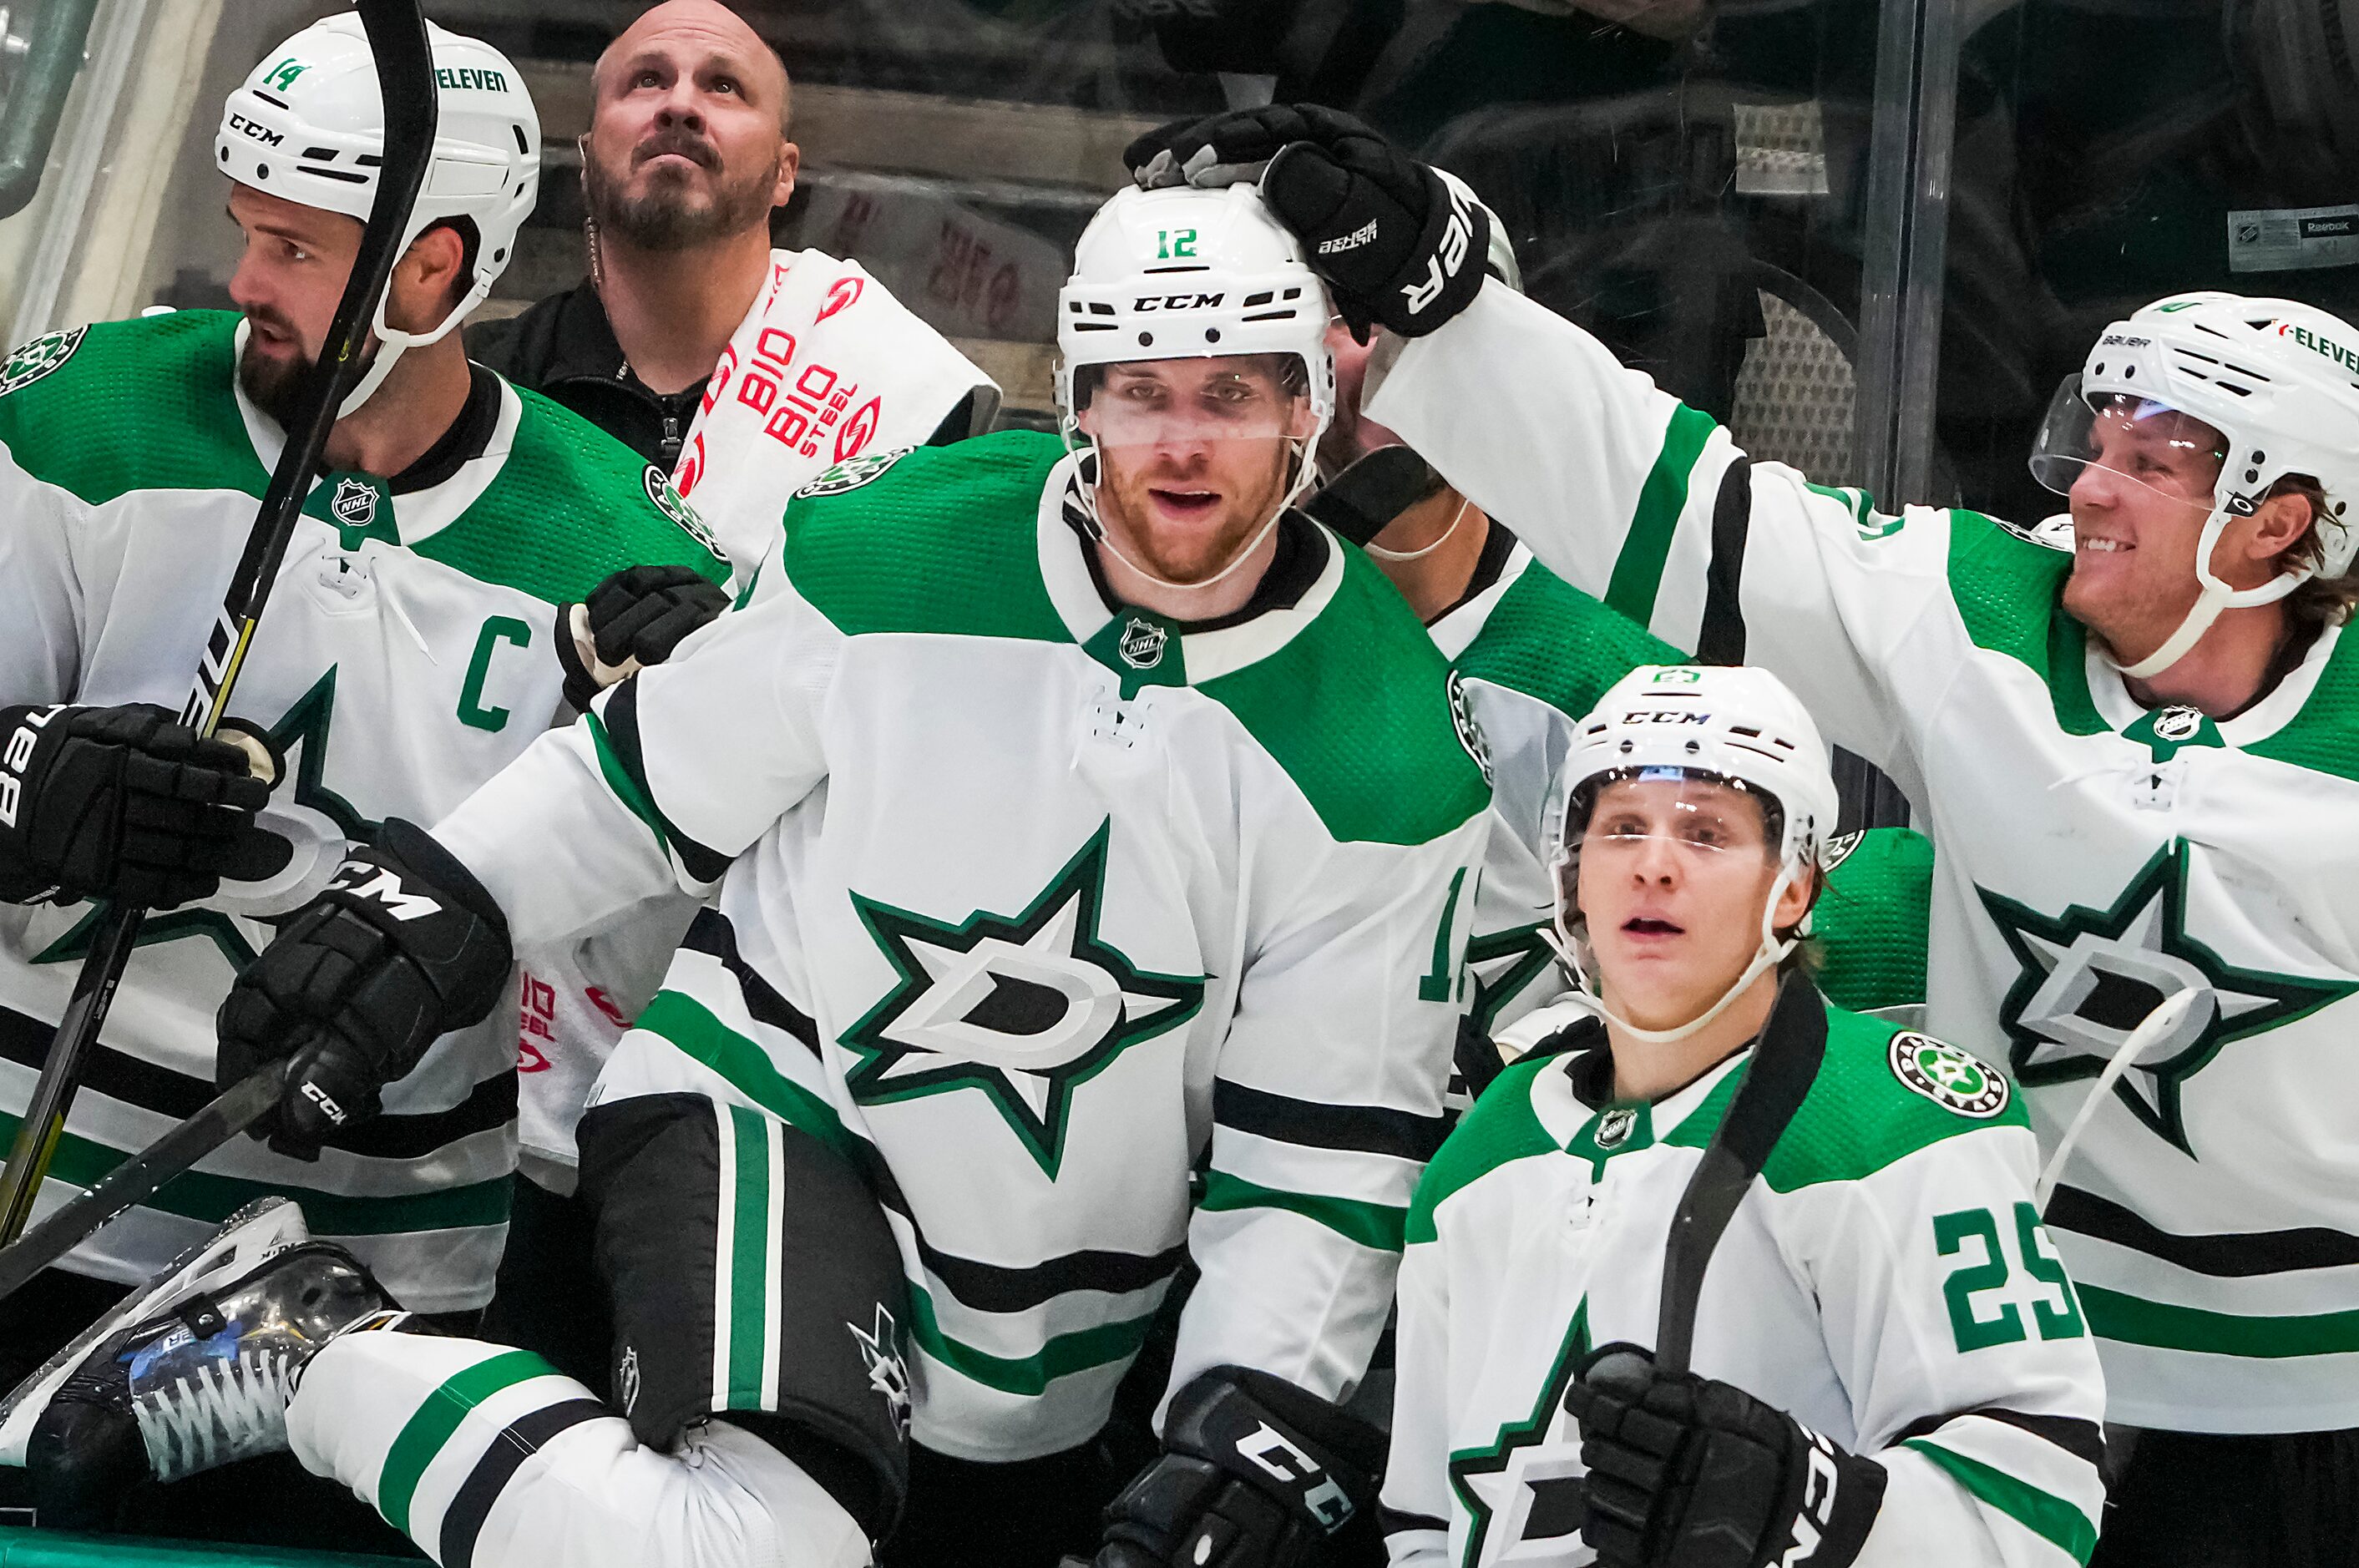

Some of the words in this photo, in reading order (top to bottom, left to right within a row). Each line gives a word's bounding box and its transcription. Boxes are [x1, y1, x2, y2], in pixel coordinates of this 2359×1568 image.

[262, 58, 312, 92] 14
[229, 113, 285, 147] CCM
[1157, 229, 1197, 259] 12
[1133, 292, 1225, 312] CCM
[737, 326, 797, 417] BIO
[763, 364, 838, 448] BIO
[799, 383, 858, 458] STEEL
[341, 496, 369, 513] NHL
[456, 615, 532, 733] C
[1622, 711, 1712, 725] CCM
[329, 860, 443, 922] CM
[1932, 1201, 2084, 1353] 25
[1235, 1419, 1356, 1535] CC
